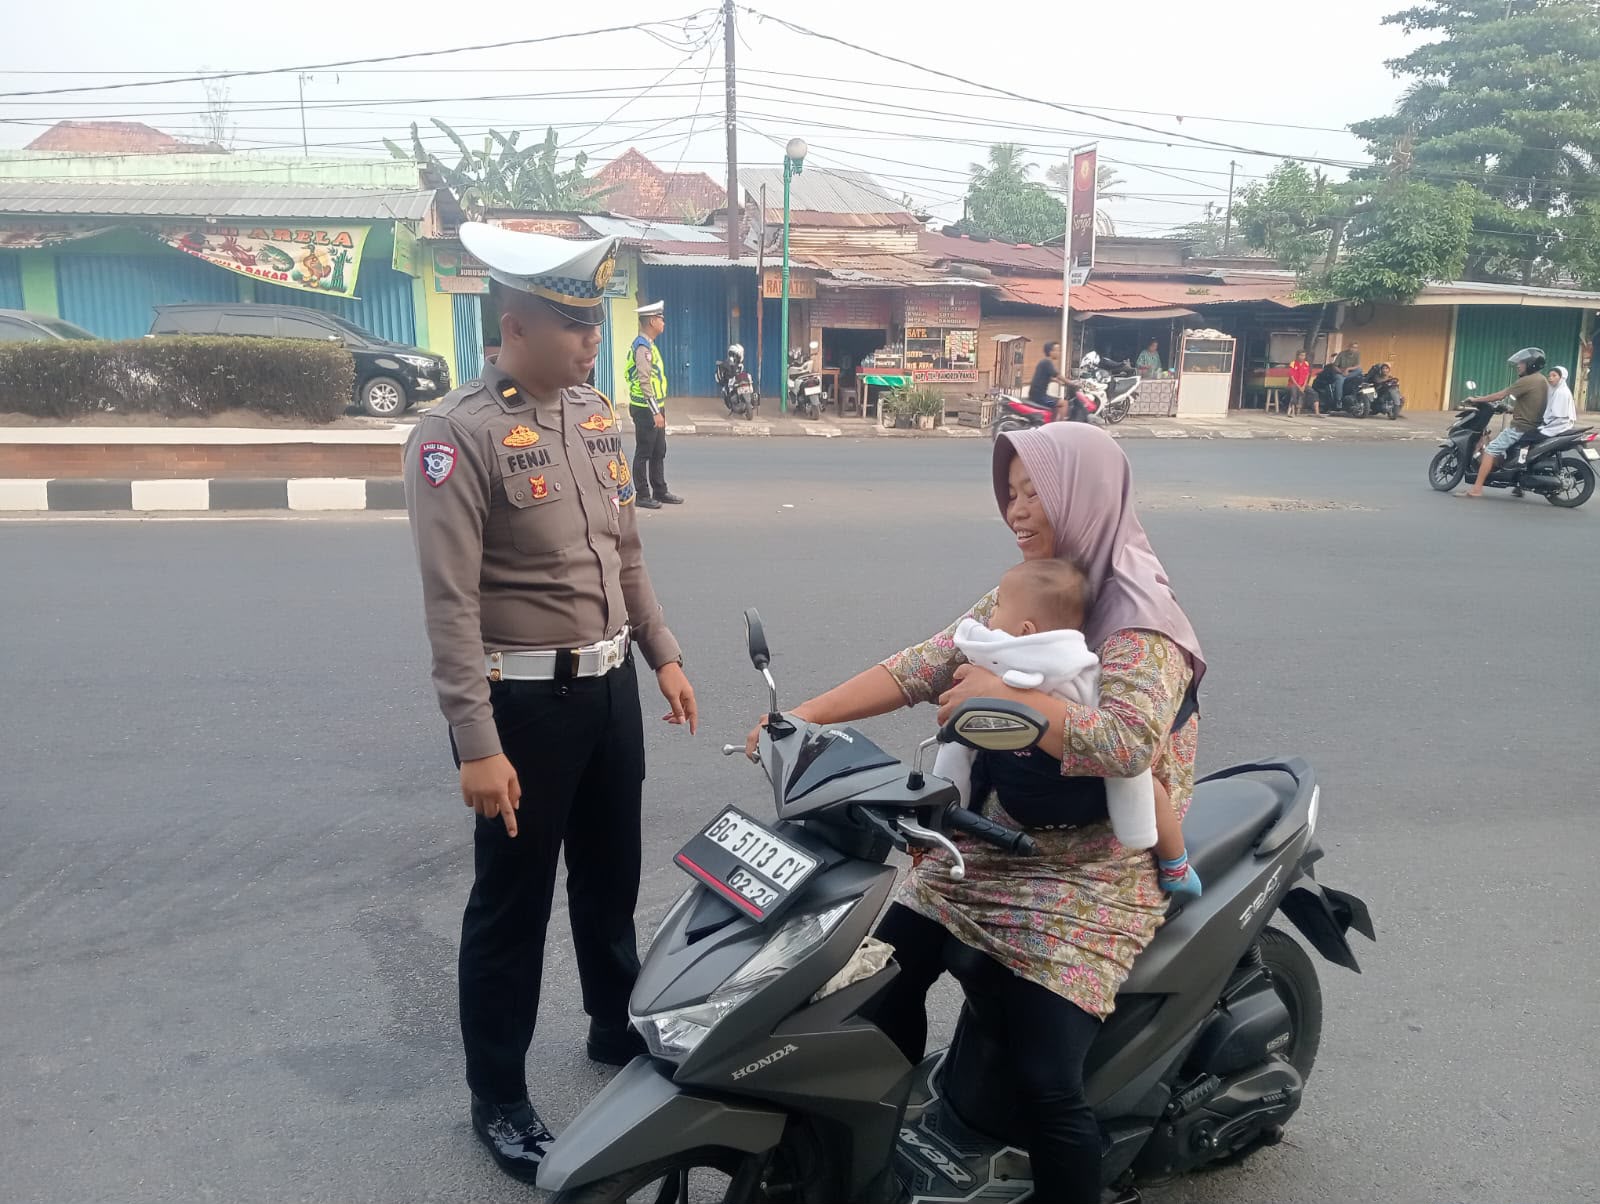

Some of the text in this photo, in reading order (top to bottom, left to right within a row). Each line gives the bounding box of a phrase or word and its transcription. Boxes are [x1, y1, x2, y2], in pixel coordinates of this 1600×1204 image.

[248, 227, 354, 248] ARELA
[766, 279, 813, 294] RADATOR
[906, 327, 928, 338] SATE
[507, 448, 552, 473] FENJI
[708, 816, 806, 885] BG 5113 CY
[731, 1043, 800, 1081] HONDA
